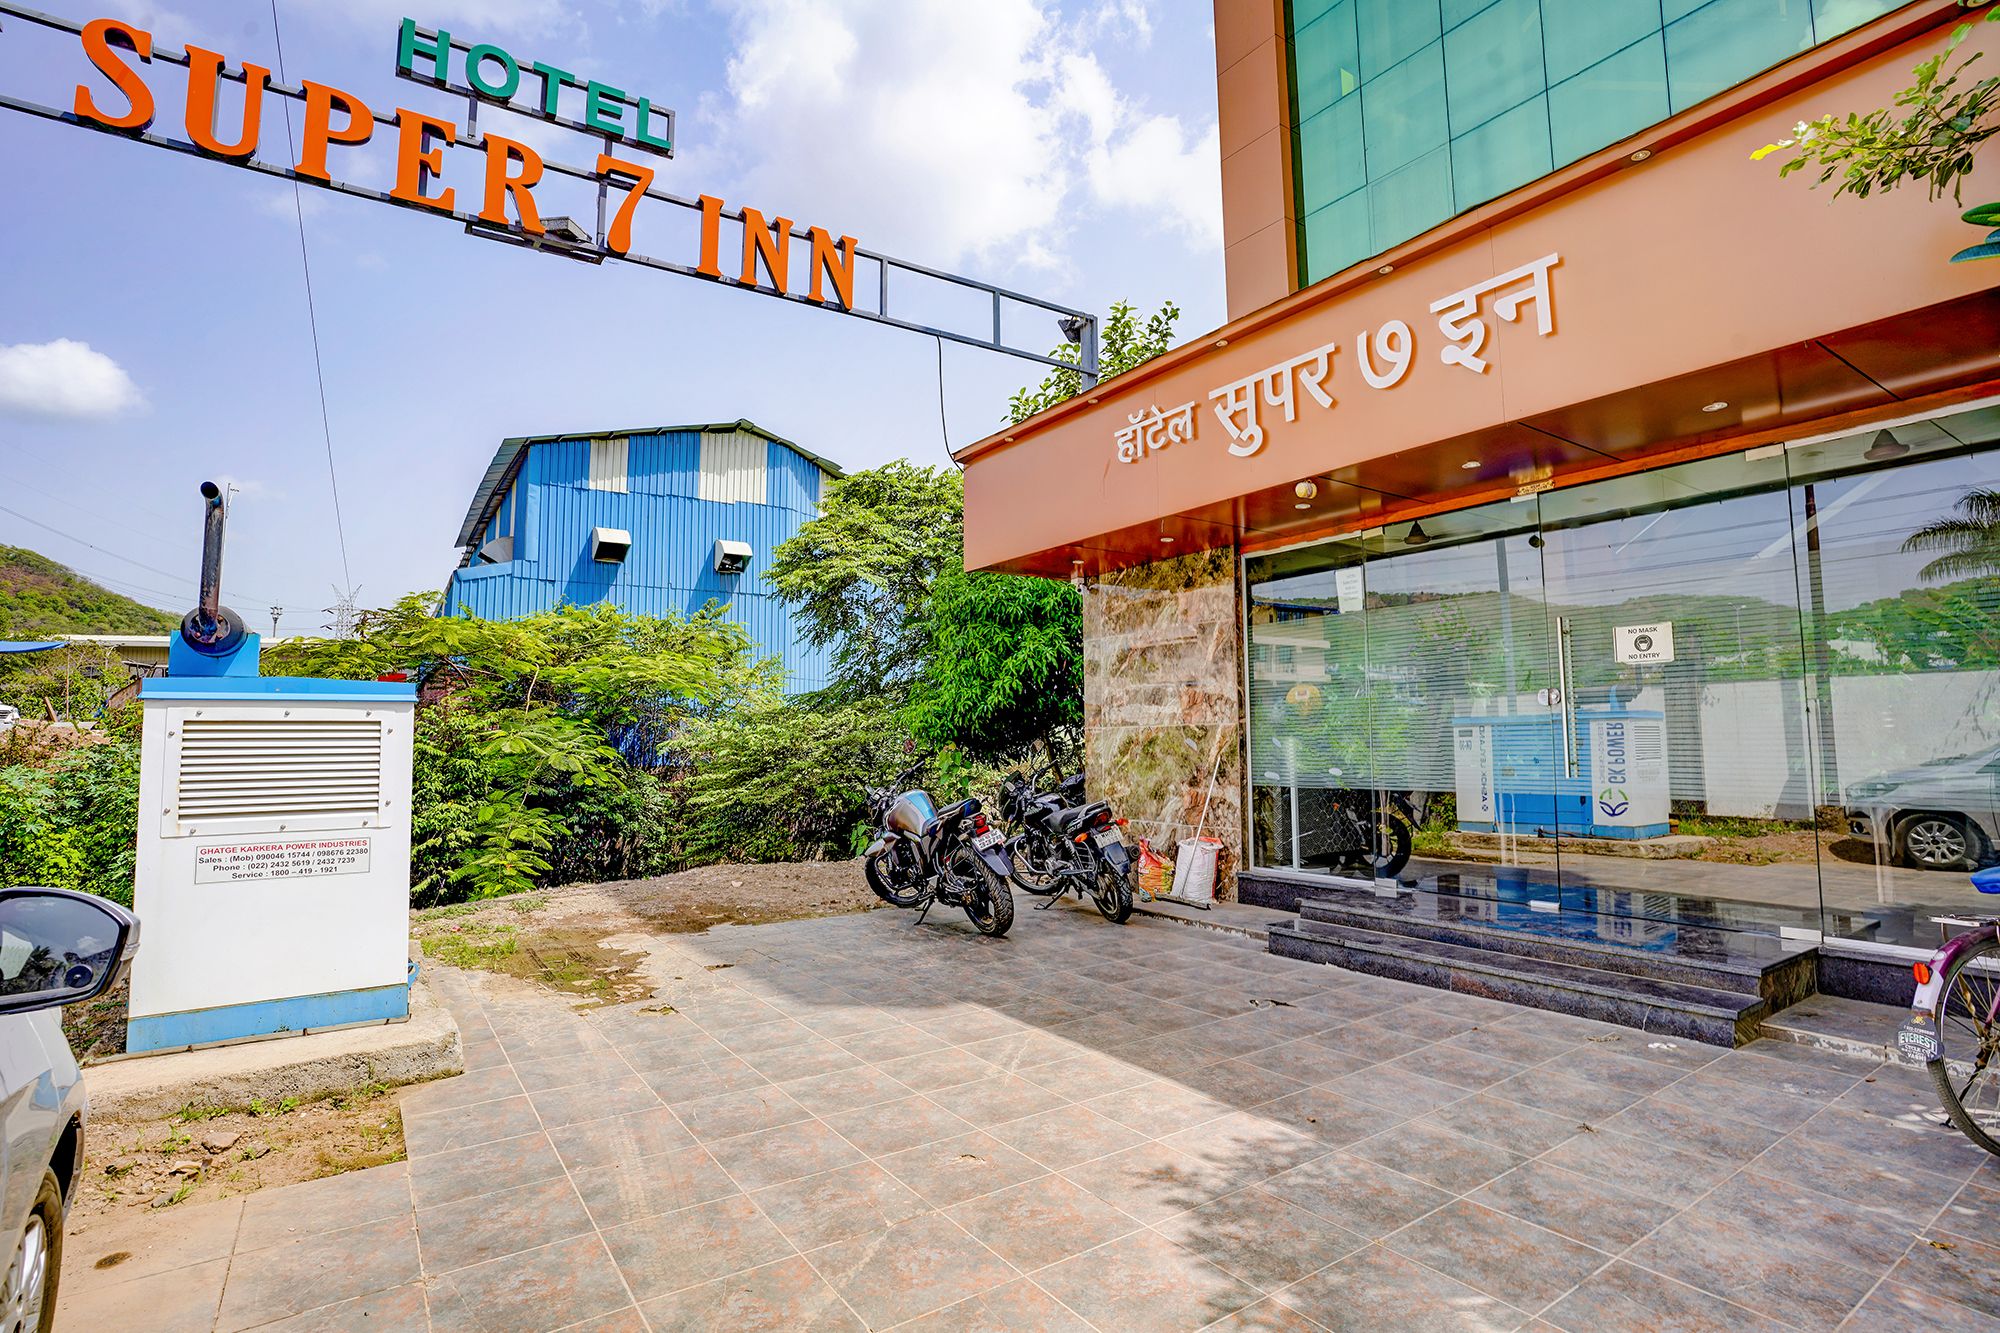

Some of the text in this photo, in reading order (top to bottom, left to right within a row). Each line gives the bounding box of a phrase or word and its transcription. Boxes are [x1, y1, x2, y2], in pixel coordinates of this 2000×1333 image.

[398, 17, 672, 149] HOTEL
[74, 18, 858, 311] SUPER 7 INN
[1115, 253, 1559, 462] हॉटेल सुपर ७ इन
[200, 840, 368, 855] GHATGE KARKERA POWER INDUSTRIES
[230, 855, 254, 863] (Mob)
[248, 862, 268, 870] (022)
[1900, 1032, 1934, 1053] EVEREST
